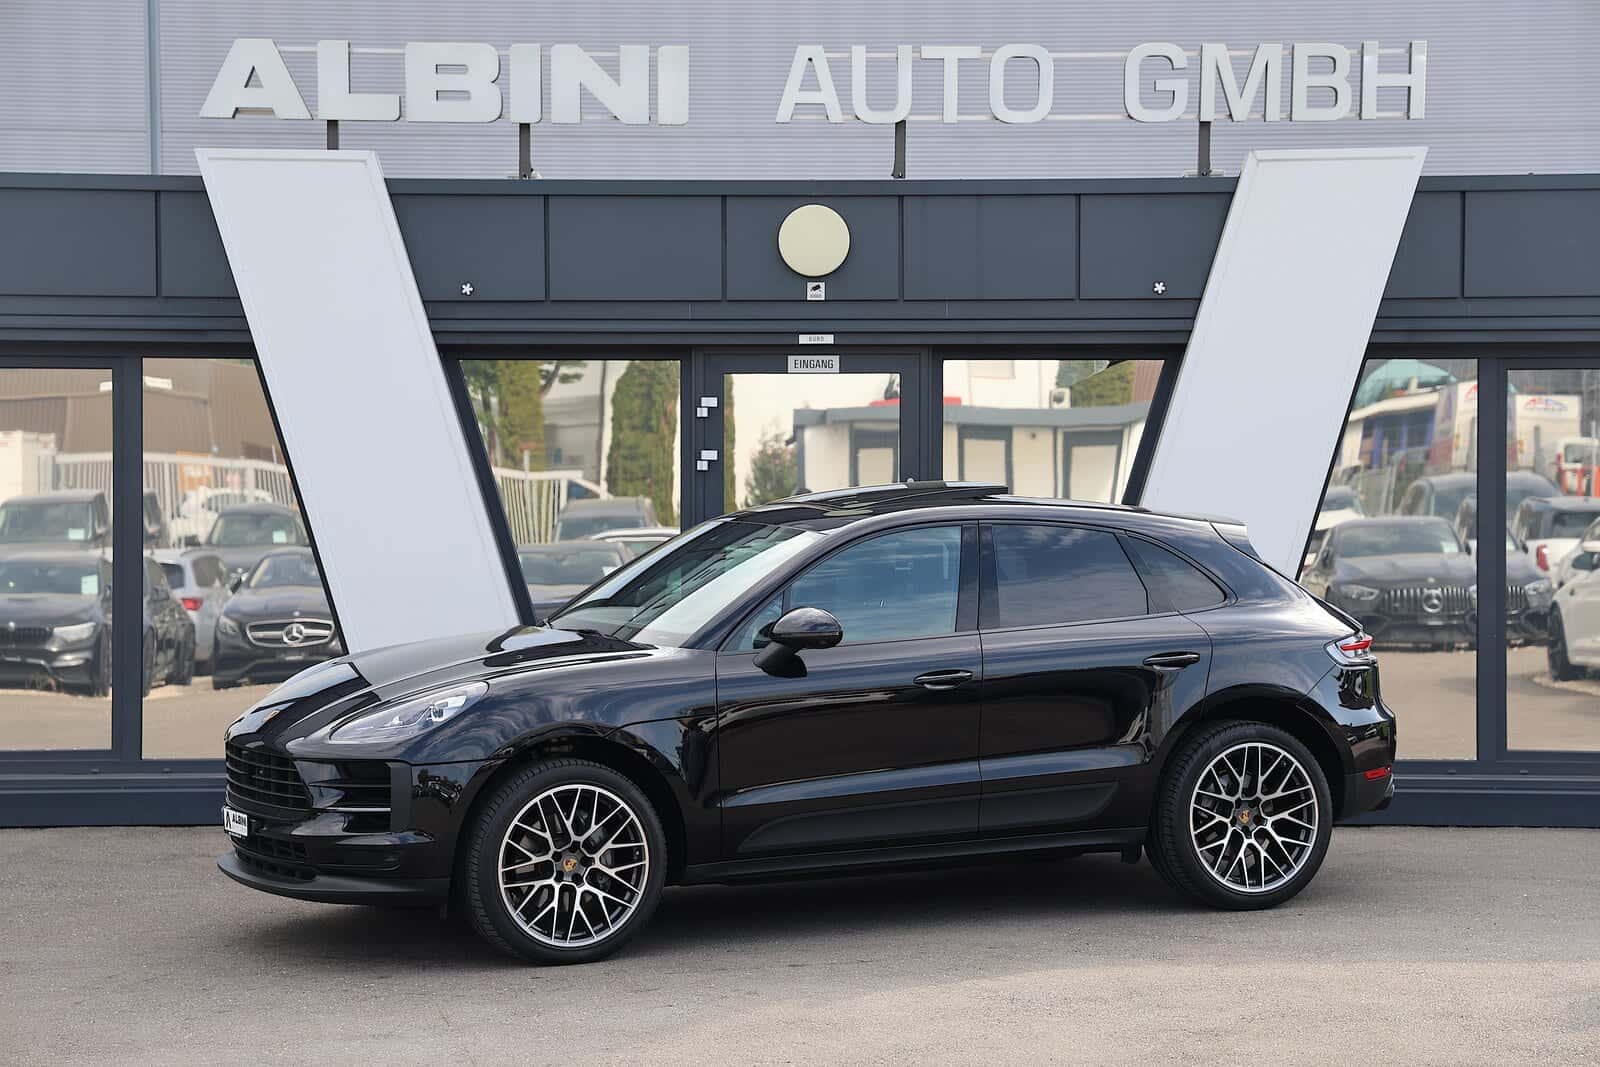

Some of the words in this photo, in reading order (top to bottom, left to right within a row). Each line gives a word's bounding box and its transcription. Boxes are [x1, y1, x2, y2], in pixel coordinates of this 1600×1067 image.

[199, 37, 690, 125] ALBINI
[776, 43, 1054, 124] AUTO
[1123, 40, 1428, 122] GMBH
[794, 359, 834, 369] EINGANG
